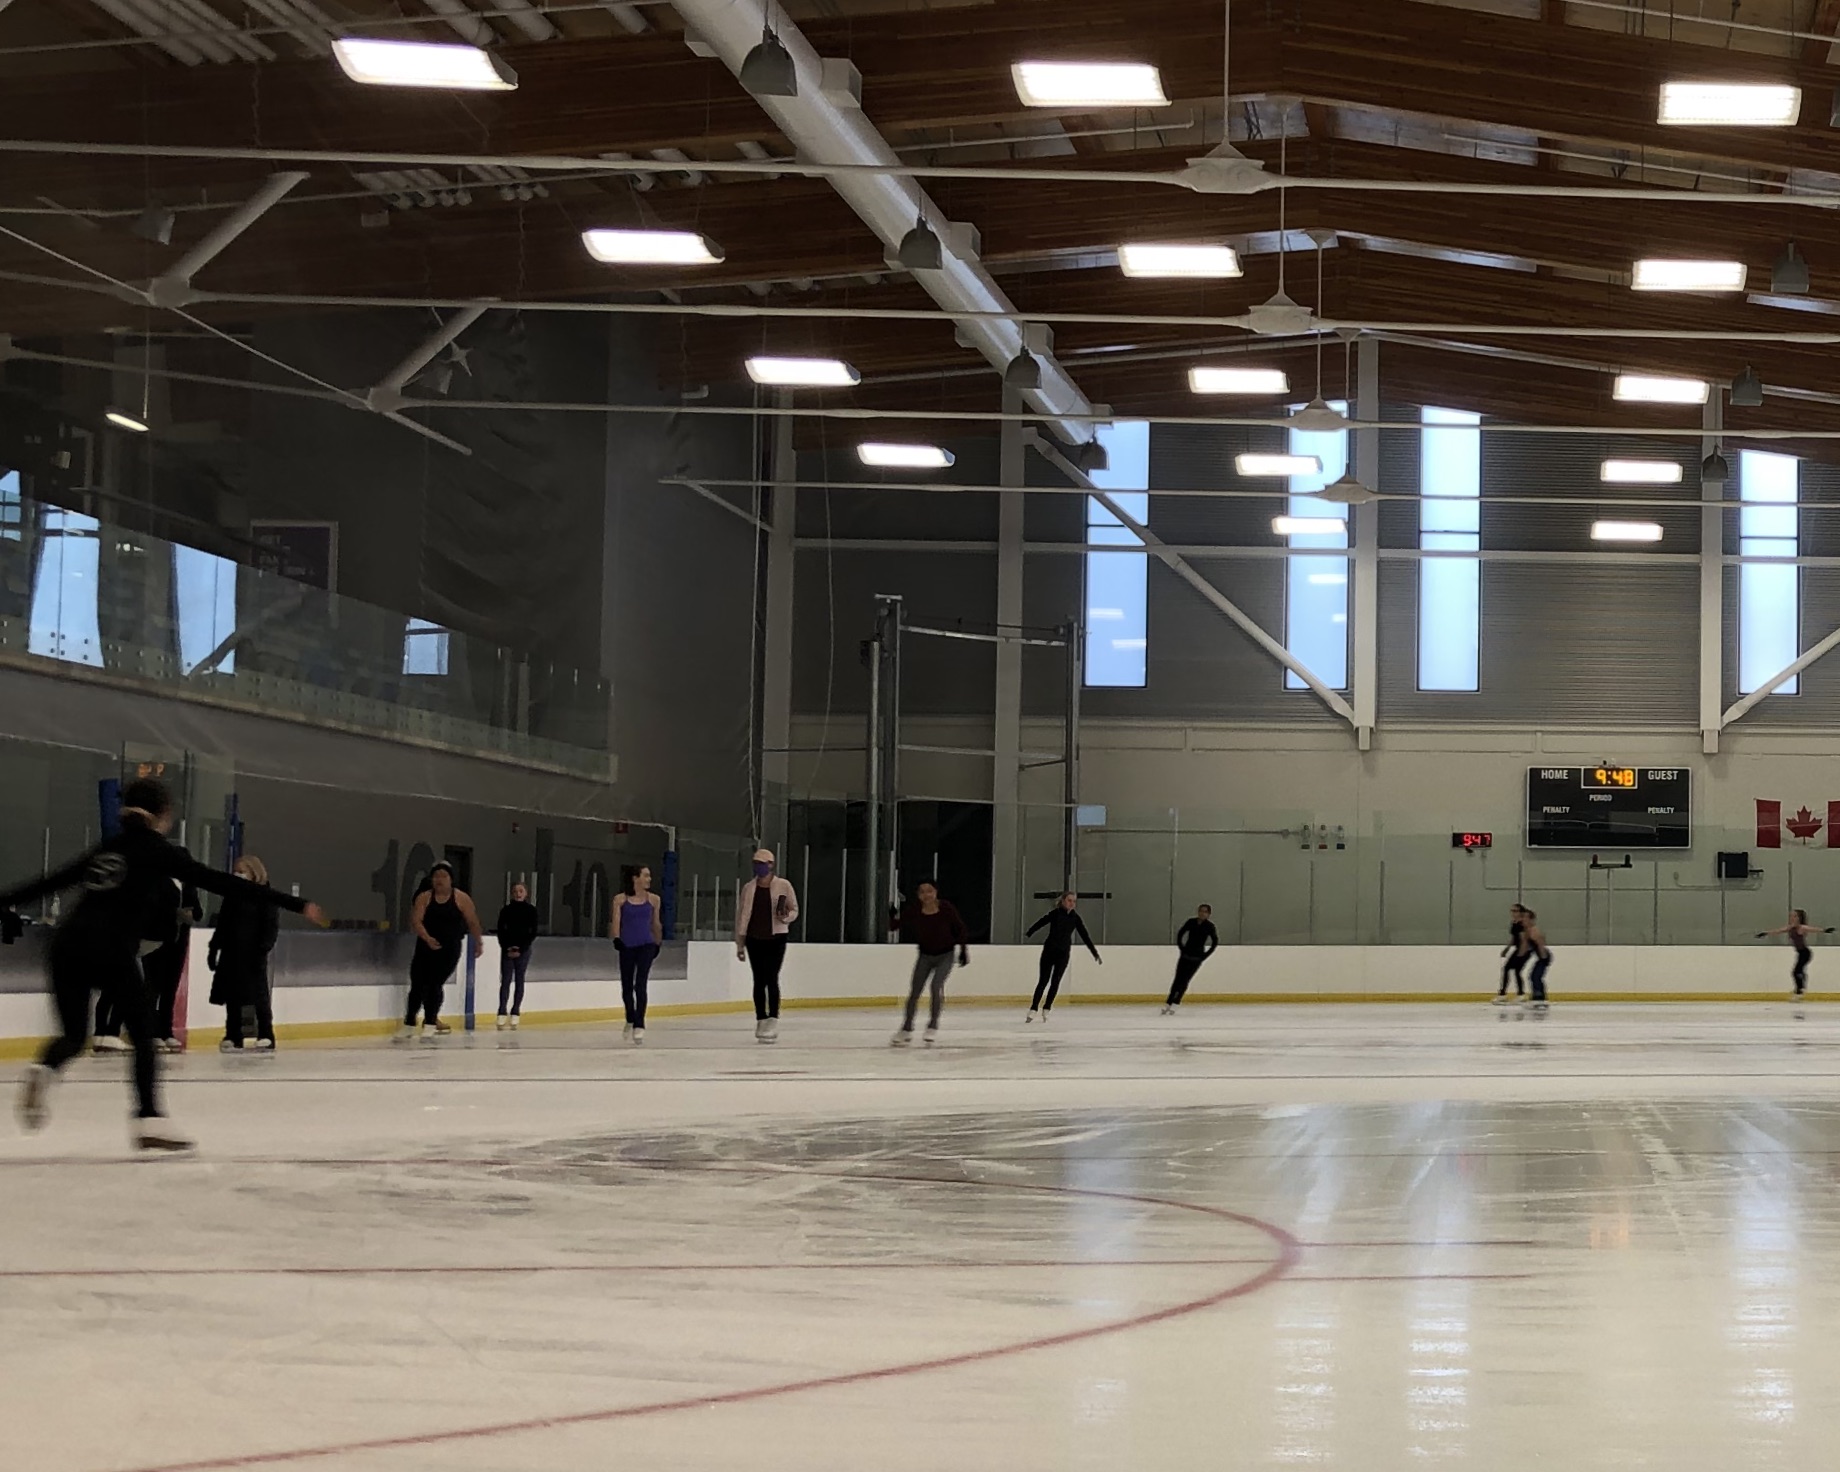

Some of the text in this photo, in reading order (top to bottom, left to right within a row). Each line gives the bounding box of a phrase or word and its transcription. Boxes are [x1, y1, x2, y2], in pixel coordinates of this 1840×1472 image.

[1541, 769, 1569, 780] HOME
[1595, 769, 1634, 787] 9:48
[1648, 770, 1679, 780] GUEST
[1589, 794, 1613, 802] PERIOD
[1542, 806, 1571, 814] PENALTY
